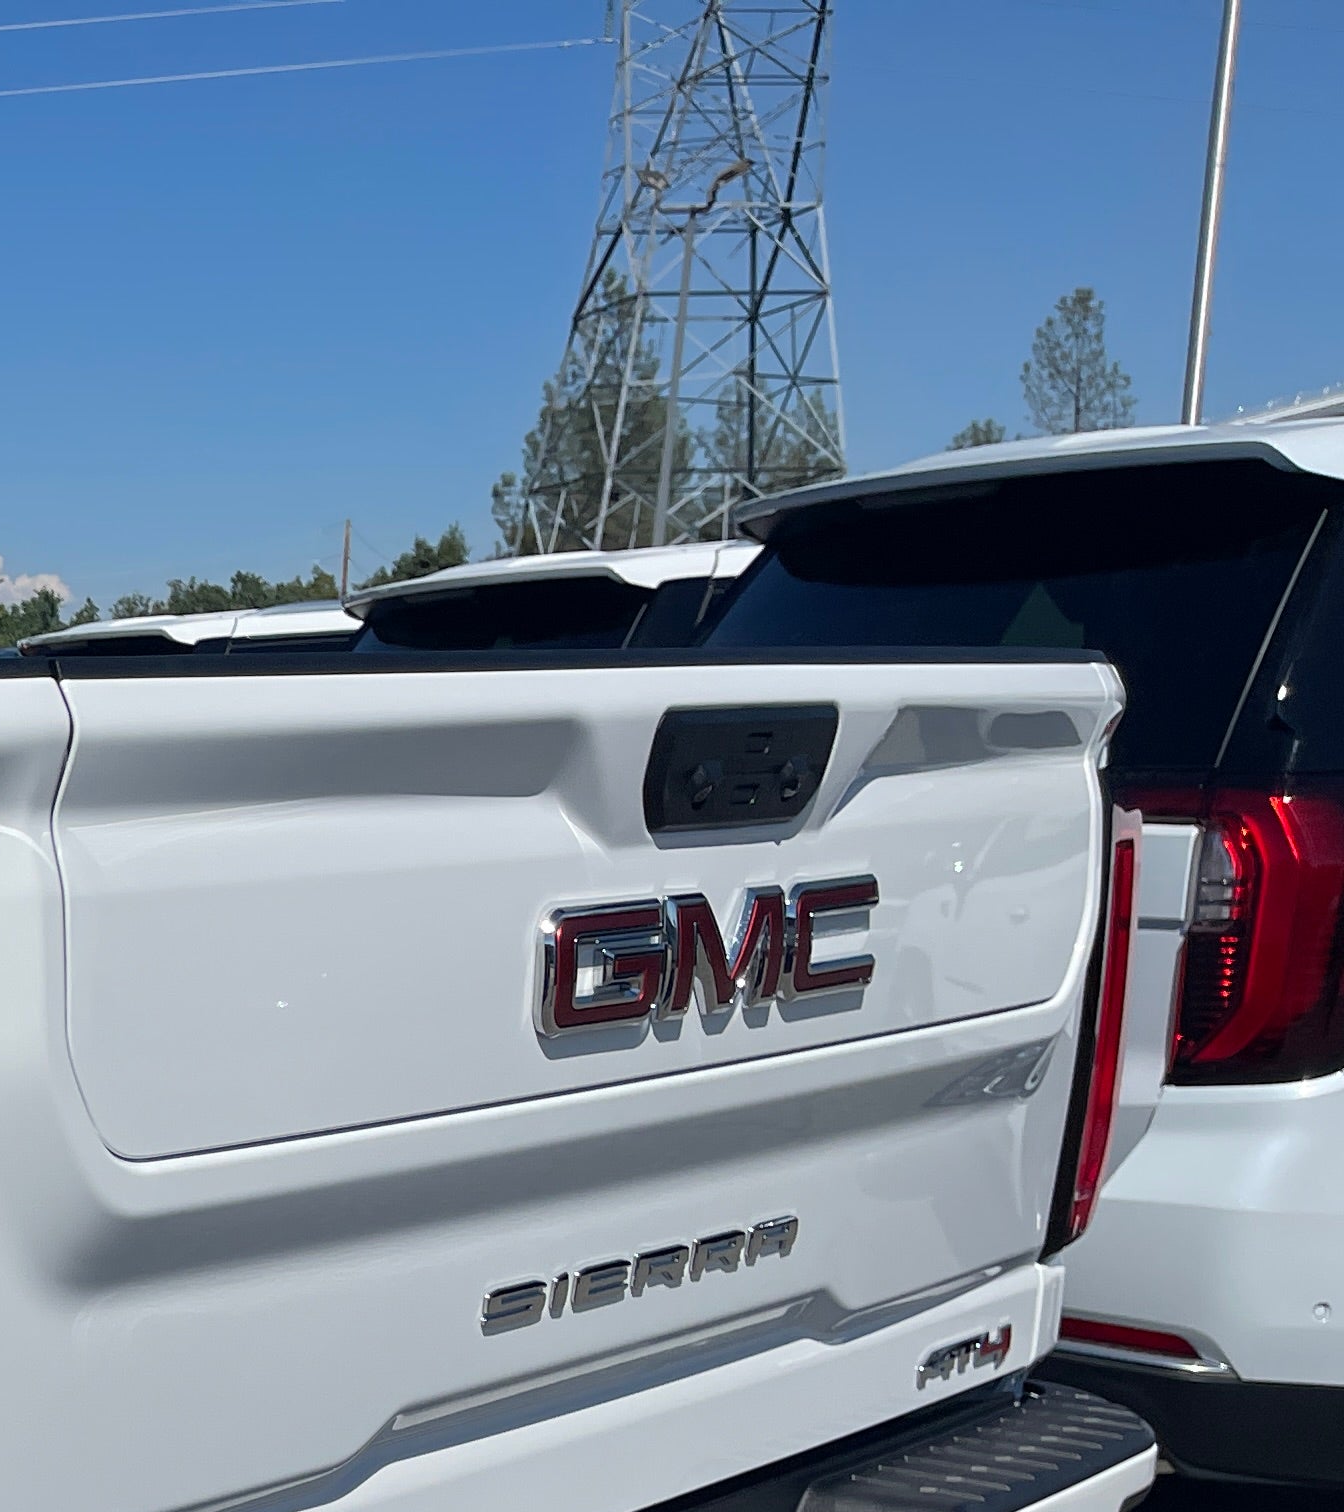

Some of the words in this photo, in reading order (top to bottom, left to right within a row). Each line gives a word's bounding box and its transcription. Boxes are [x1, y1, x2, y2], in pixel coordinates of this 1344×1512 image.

[534, 873, 879, 1037] GMC
[480, 1215, 799, 1336] SIERRA
[916, 1324, 1012, 1391] AT4
